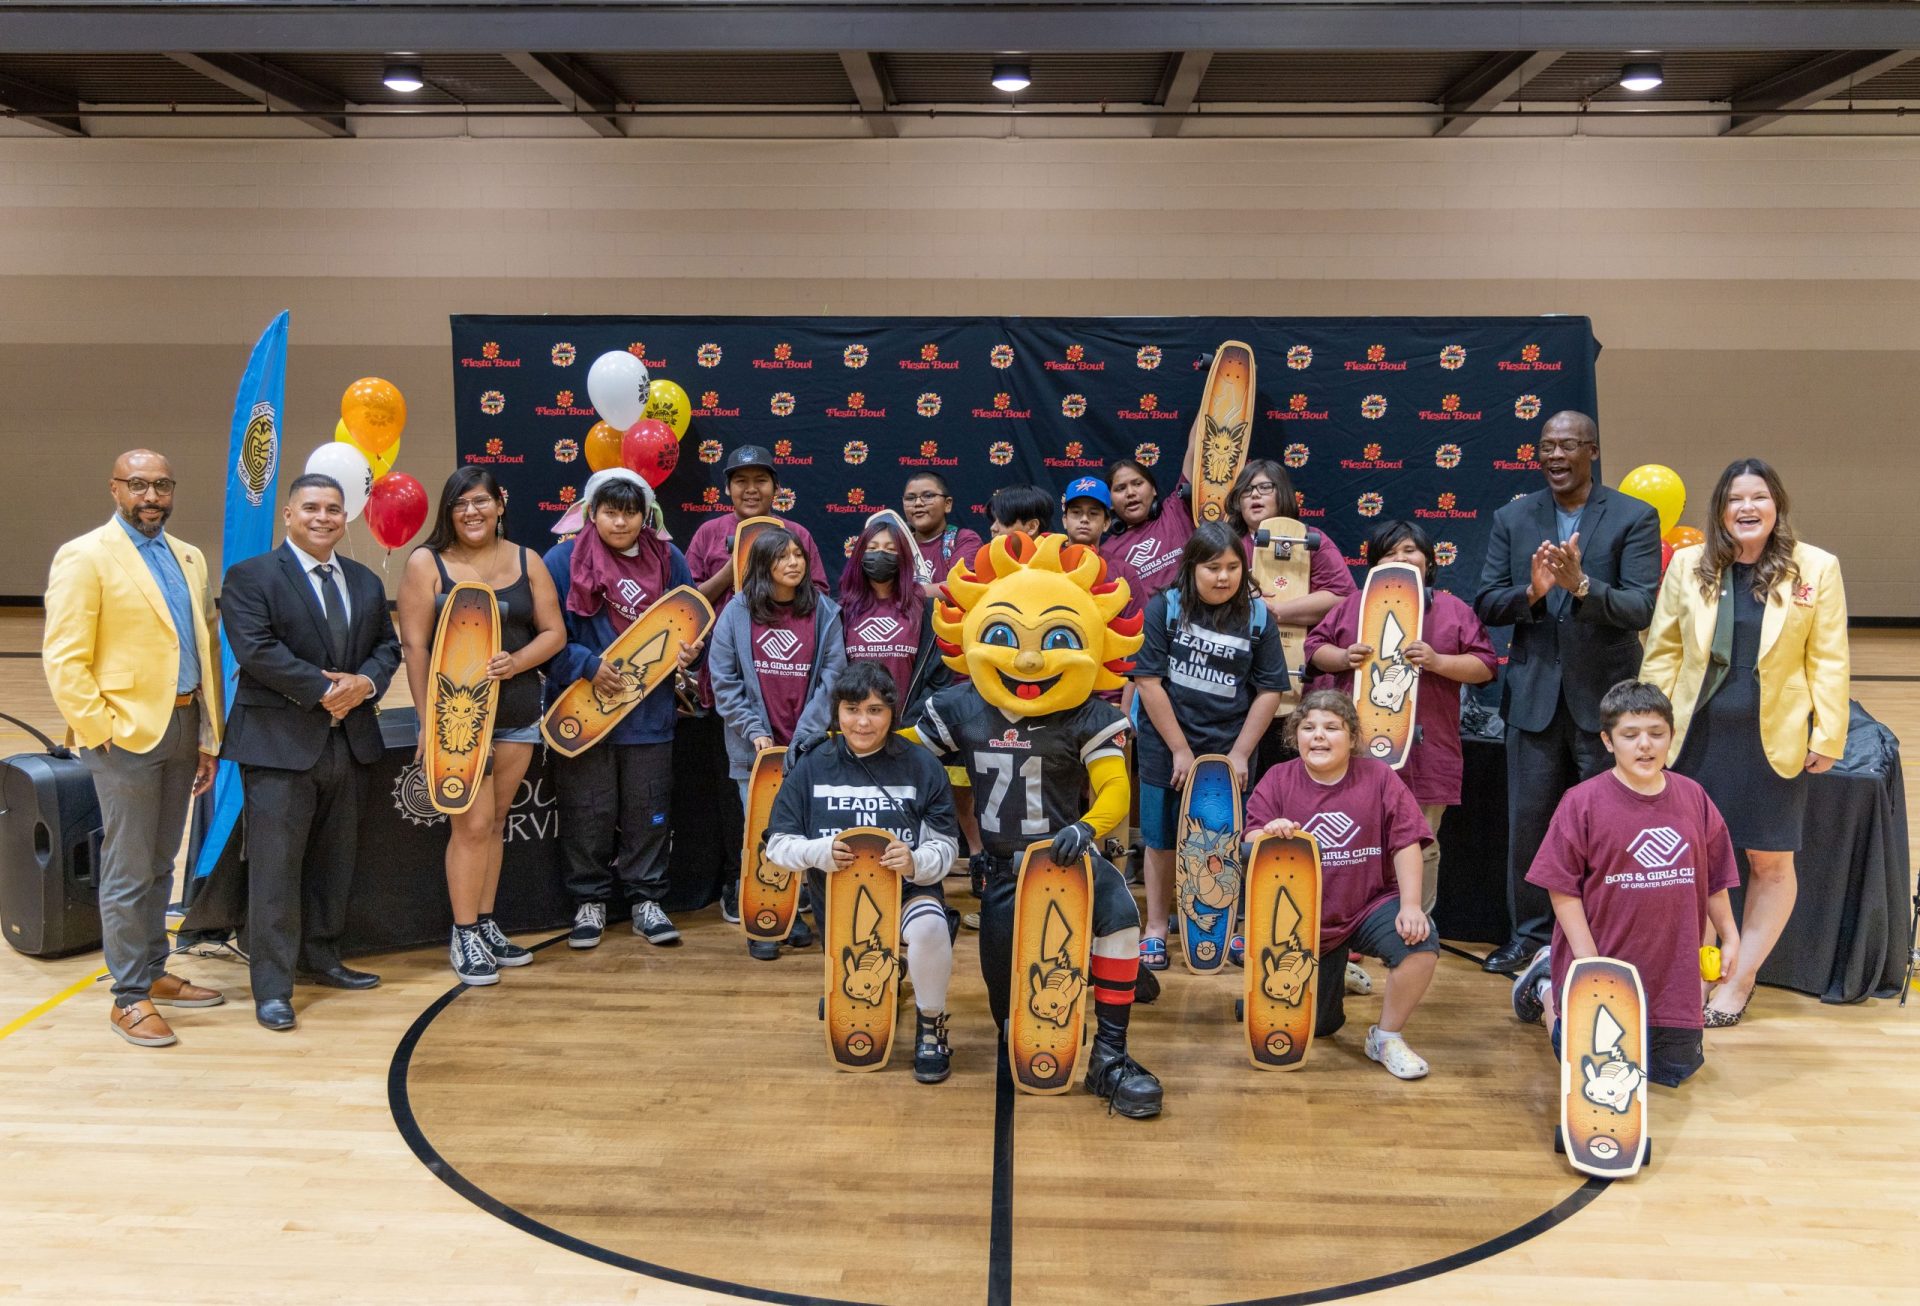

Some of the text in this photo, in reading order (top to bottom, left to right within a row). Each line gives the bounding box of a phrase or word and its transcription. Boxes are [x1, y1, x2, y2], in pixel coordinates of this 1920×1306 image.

[461, 358, 521, 368] Fiesta Bowl
[752, 359, 812, 369] Fiesta Bowl
[899, 360, 959, 370] Fiesta Bowl
[1044, 361, 1105, 371] Fiesta Bowl
[1344, 361, 1407, 371] Fiesta Bowl
[1498, 360, 1562, 371] Fiesta Bowl
[535, 407, 594, 416] Fiesta Bowl
[690, 408, 740, 417] esta Bowl
[825, 408, 886, 418] Fiesta Bowl
[972, 409, 1031, 419] Fiesta Bowl
[1117, 410, 1178, 420] Fiesta Bowl
[1266, 410, 1329, 420] Fiesta Bowl
[1418, 411, 1482, 421] Fiesta Bowl
[465, 454, 524, 464] Fiesta Bowl
[785, 456, 813, 465] Bowl
[899, 456, 958, 466] Fiesta Bowl
[1044, 457, 1104, 467] Fiesta Bowl
[1341, 459, 1403, 469] Fiesta Bowl
[1493, 460, 1526, 470] Fiesta
[681, 503, 712, 512] Fiesta
[826, 503, 857, 513] Fiesta
[1414, 509, 1477, 519] Fiesta Bowl
[858, 644, 866, 652] &
[867, 644, 893, 652] GIRLS
[1189, 650, 1209, 666] IN
[762, 661, 769, 669] &
[770, 661, 794, 671] GIRLS
[973, 751, 1050, 835] 71
[827, 797, 905, 812] LEADER
[855, 812, 877, 826] IN
[1352, 846, 1382, 858] CLUBS
[1332, 856, 1367, 867] SCOTTSDALE
[1605, 872, 1633, 884] BOYS
[1635, 872, 1645, 881] &
[1646, 869, 1678, 881] GIRLS
[1630, 880, 1660, 889] GREATER
